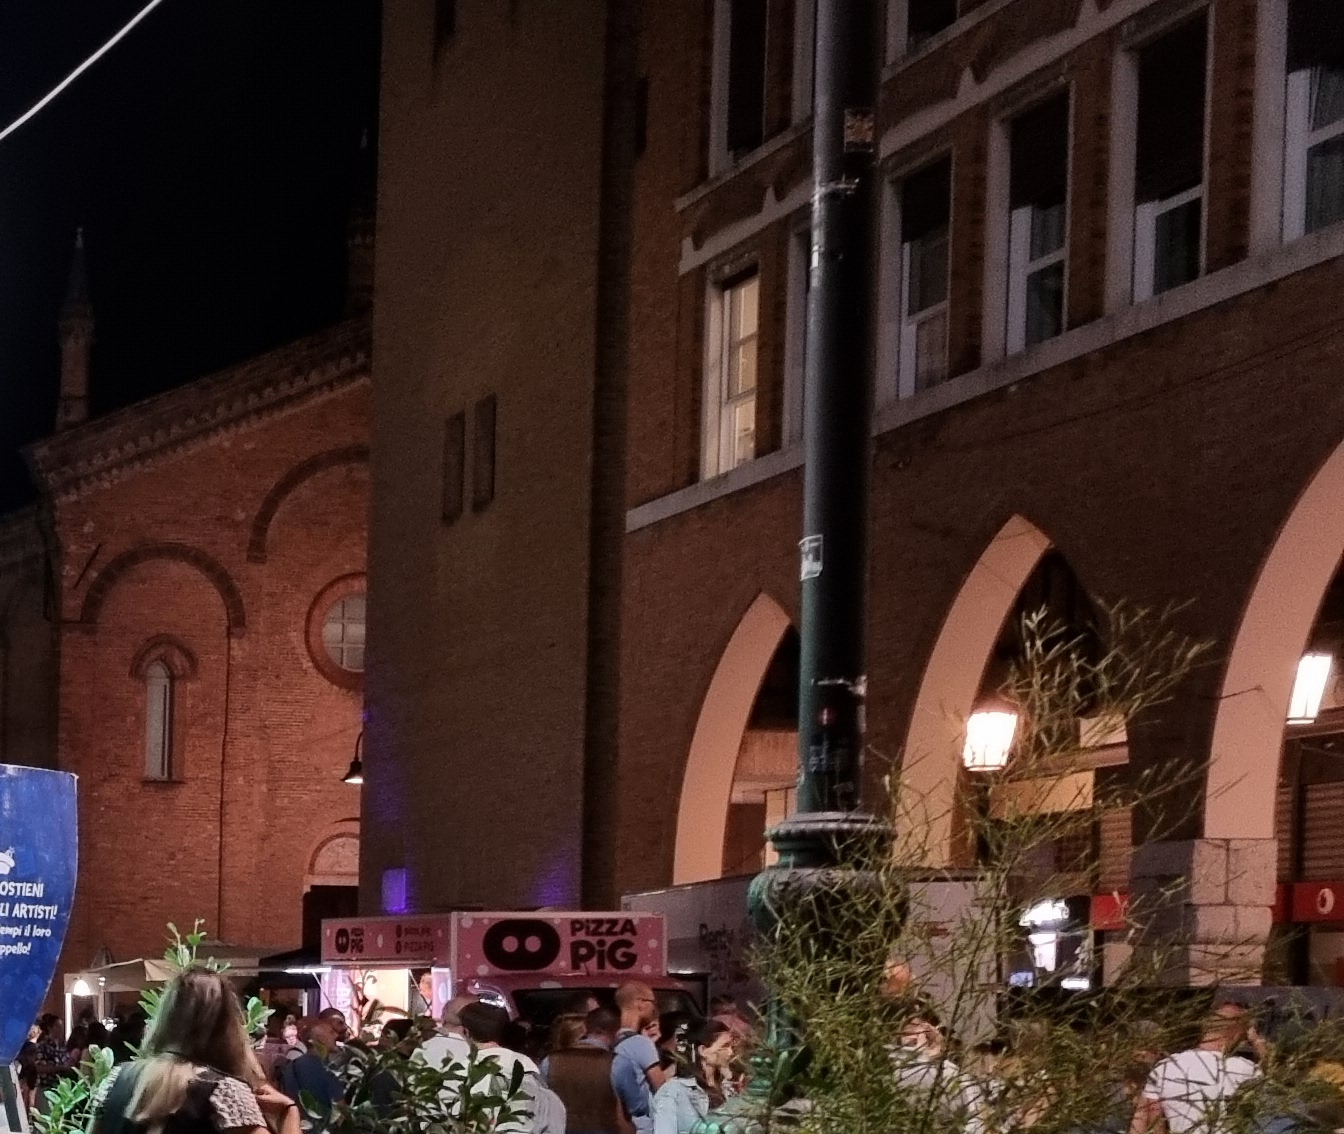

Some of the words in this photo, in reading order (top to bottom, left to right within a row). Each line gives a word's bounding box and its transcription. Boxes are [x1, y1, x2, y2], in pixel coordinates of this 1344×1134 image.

[12, 904, 58, 919] ARTISTI!
[24, 923, 30, 937] il
[32, 923, 52, 937] loro
